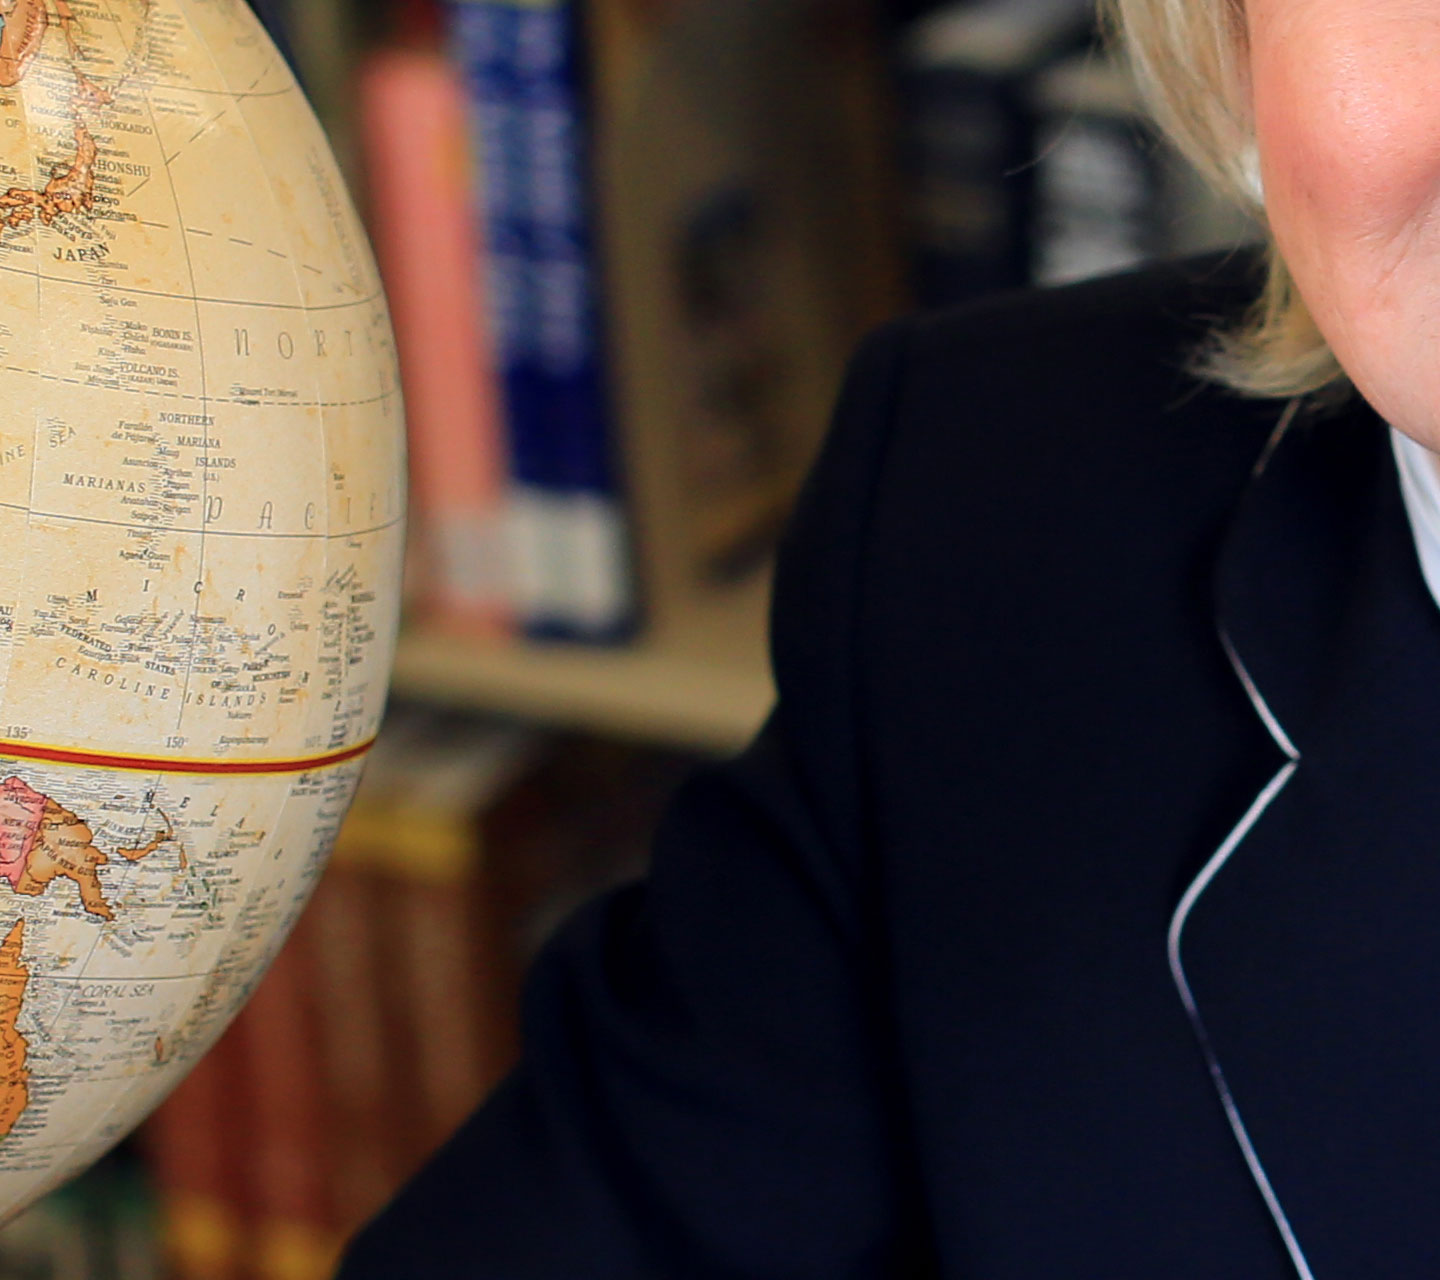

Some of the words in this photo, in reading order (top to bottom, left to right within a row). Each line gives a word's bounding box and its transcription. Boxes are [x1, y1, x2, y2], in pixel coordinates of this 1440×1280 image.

[52, 241, 112, 263] JAPAN
[159, 411, 216, 427] NORTHERN
[48, 425, 78, 449] SEA
[176, 435, 222, 450] MARIANA
[194, 456, 237, 470] ISLANDS
[62, 473, 147, 494] MARIANAS
[55, 656, 171, 701] CAROLINE
[185, 692, 268, 707] ISLANDS
